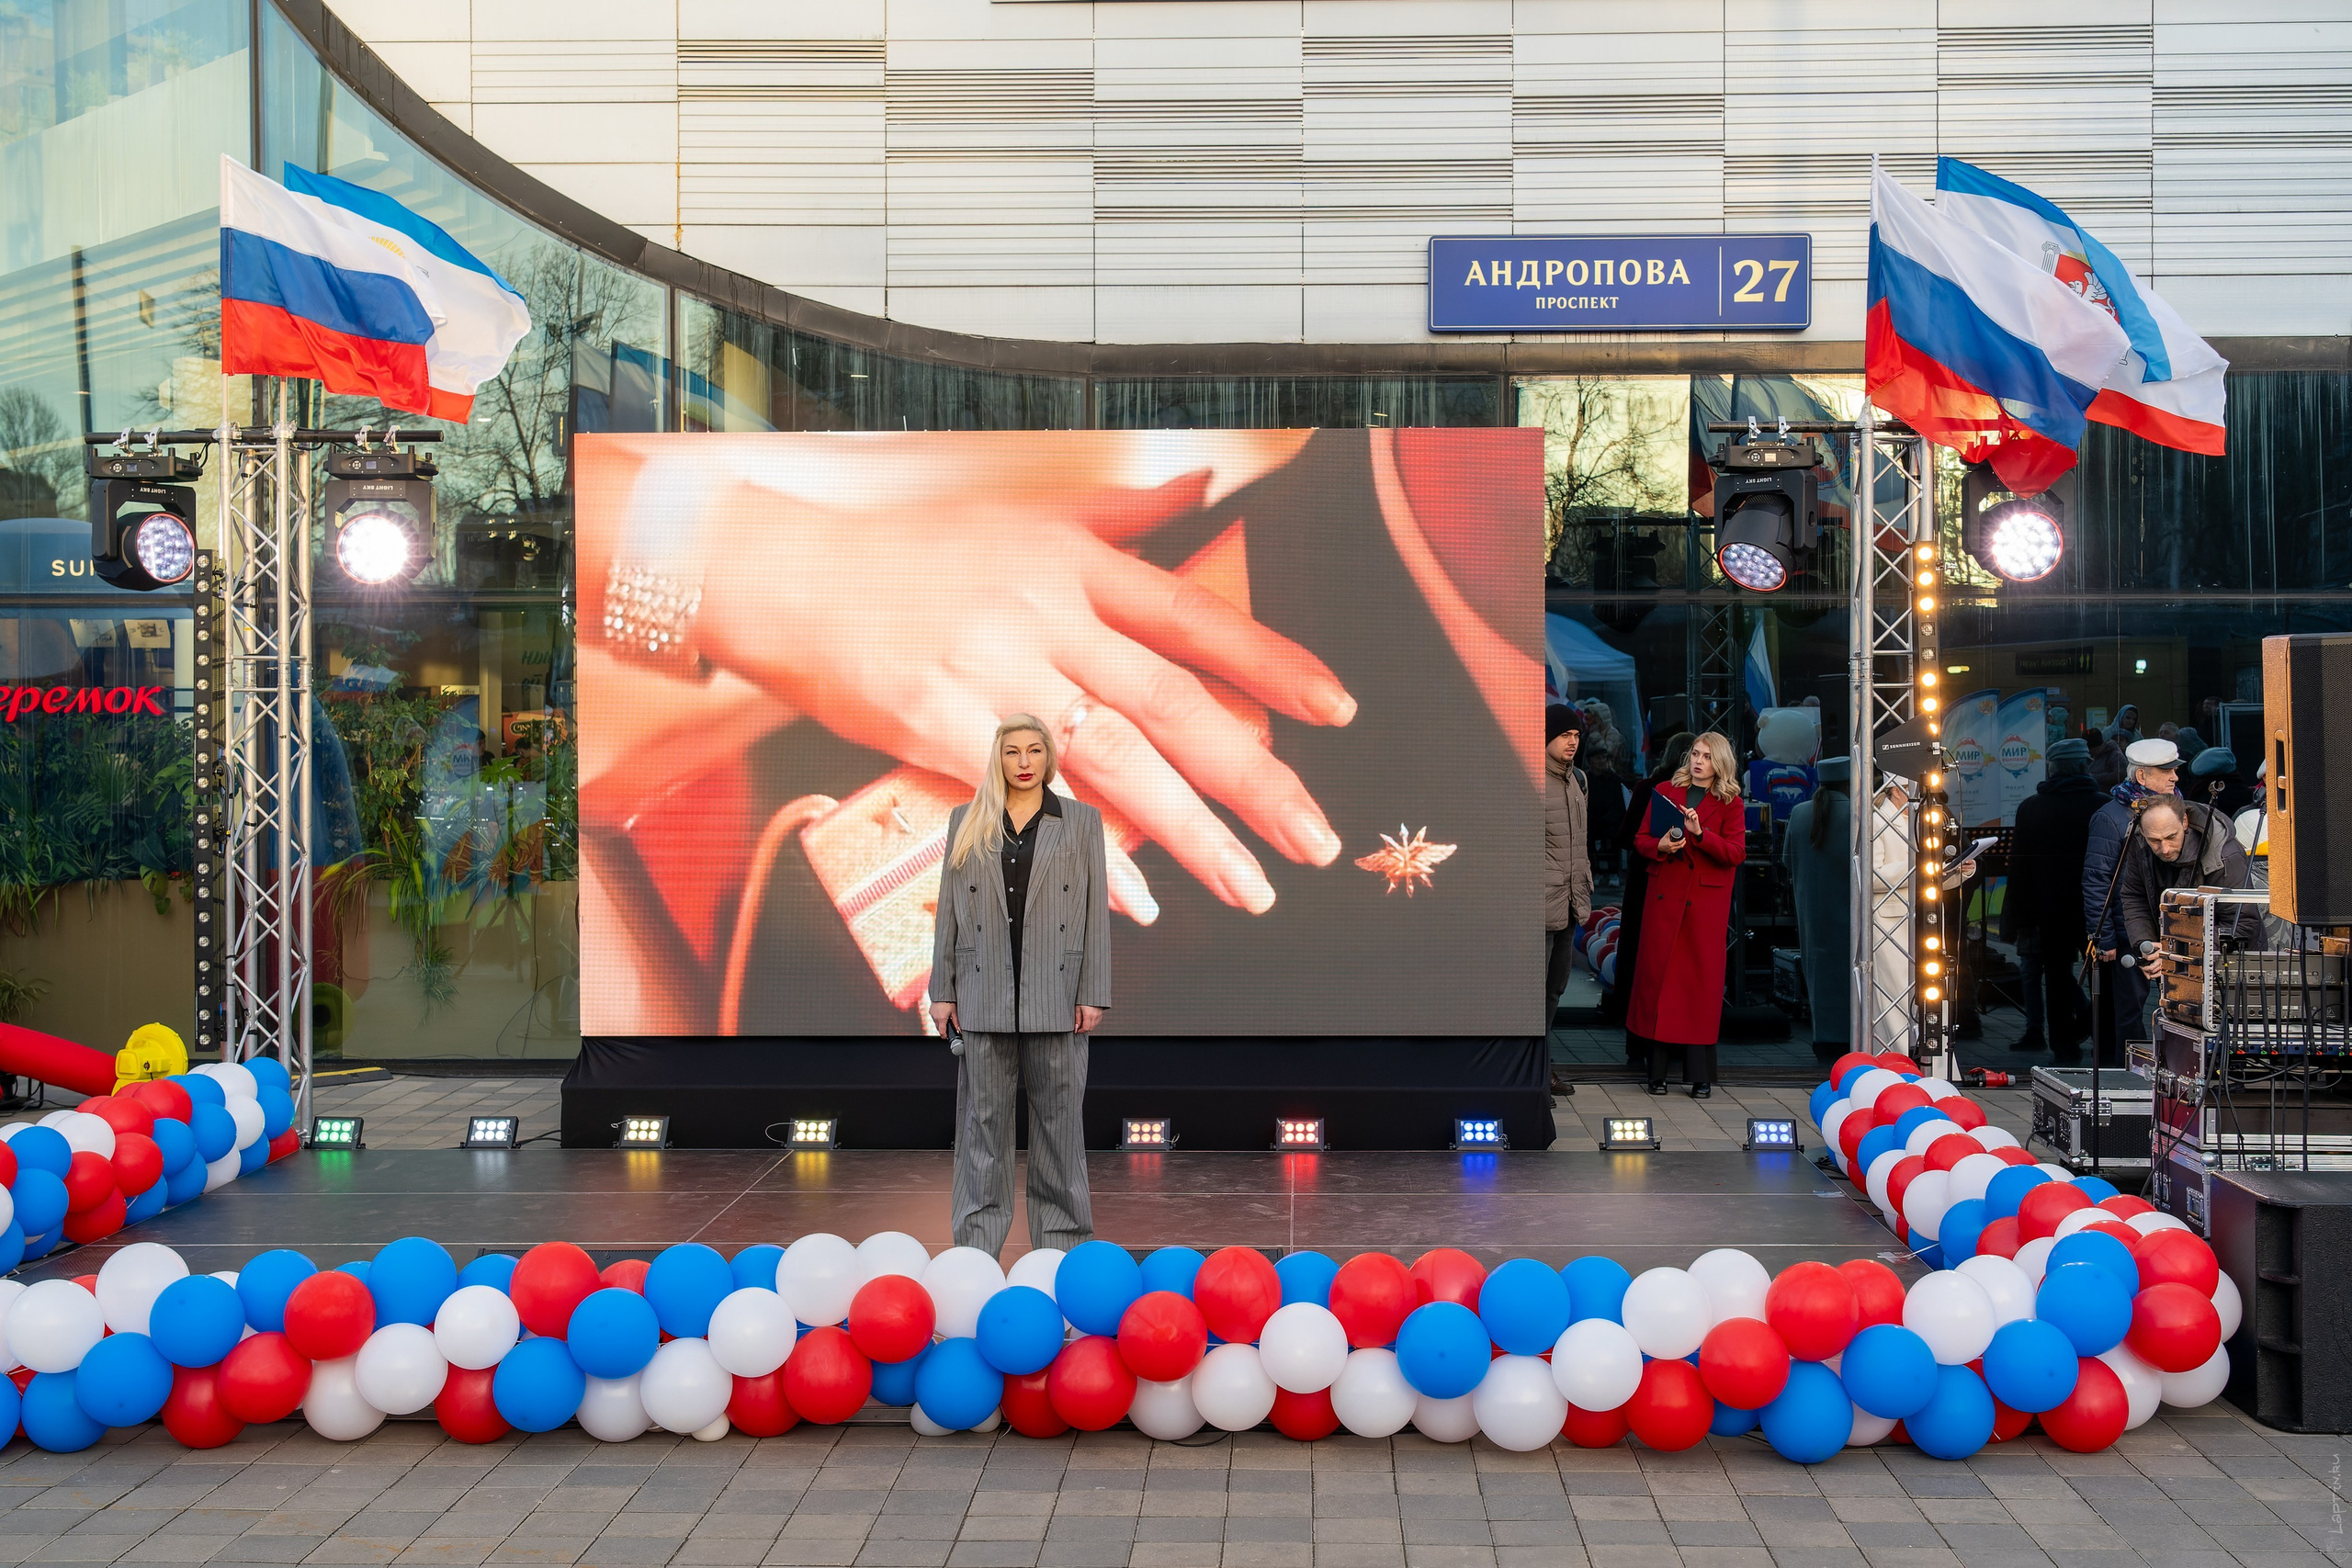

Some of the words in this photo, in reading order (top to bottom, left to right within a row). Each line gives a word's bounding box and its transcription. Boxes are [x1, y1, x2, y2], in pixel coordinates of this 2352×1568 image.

[1464, 258, 1691, 290] АНДРОПОВА
[1733, 259, 1801, 302] 27
[1535, 296, 1620, 310] ПРОСПЕКТ
[1955, 750, 1981, 761] МИР
[2002, 747, 2027, 757] МИР
